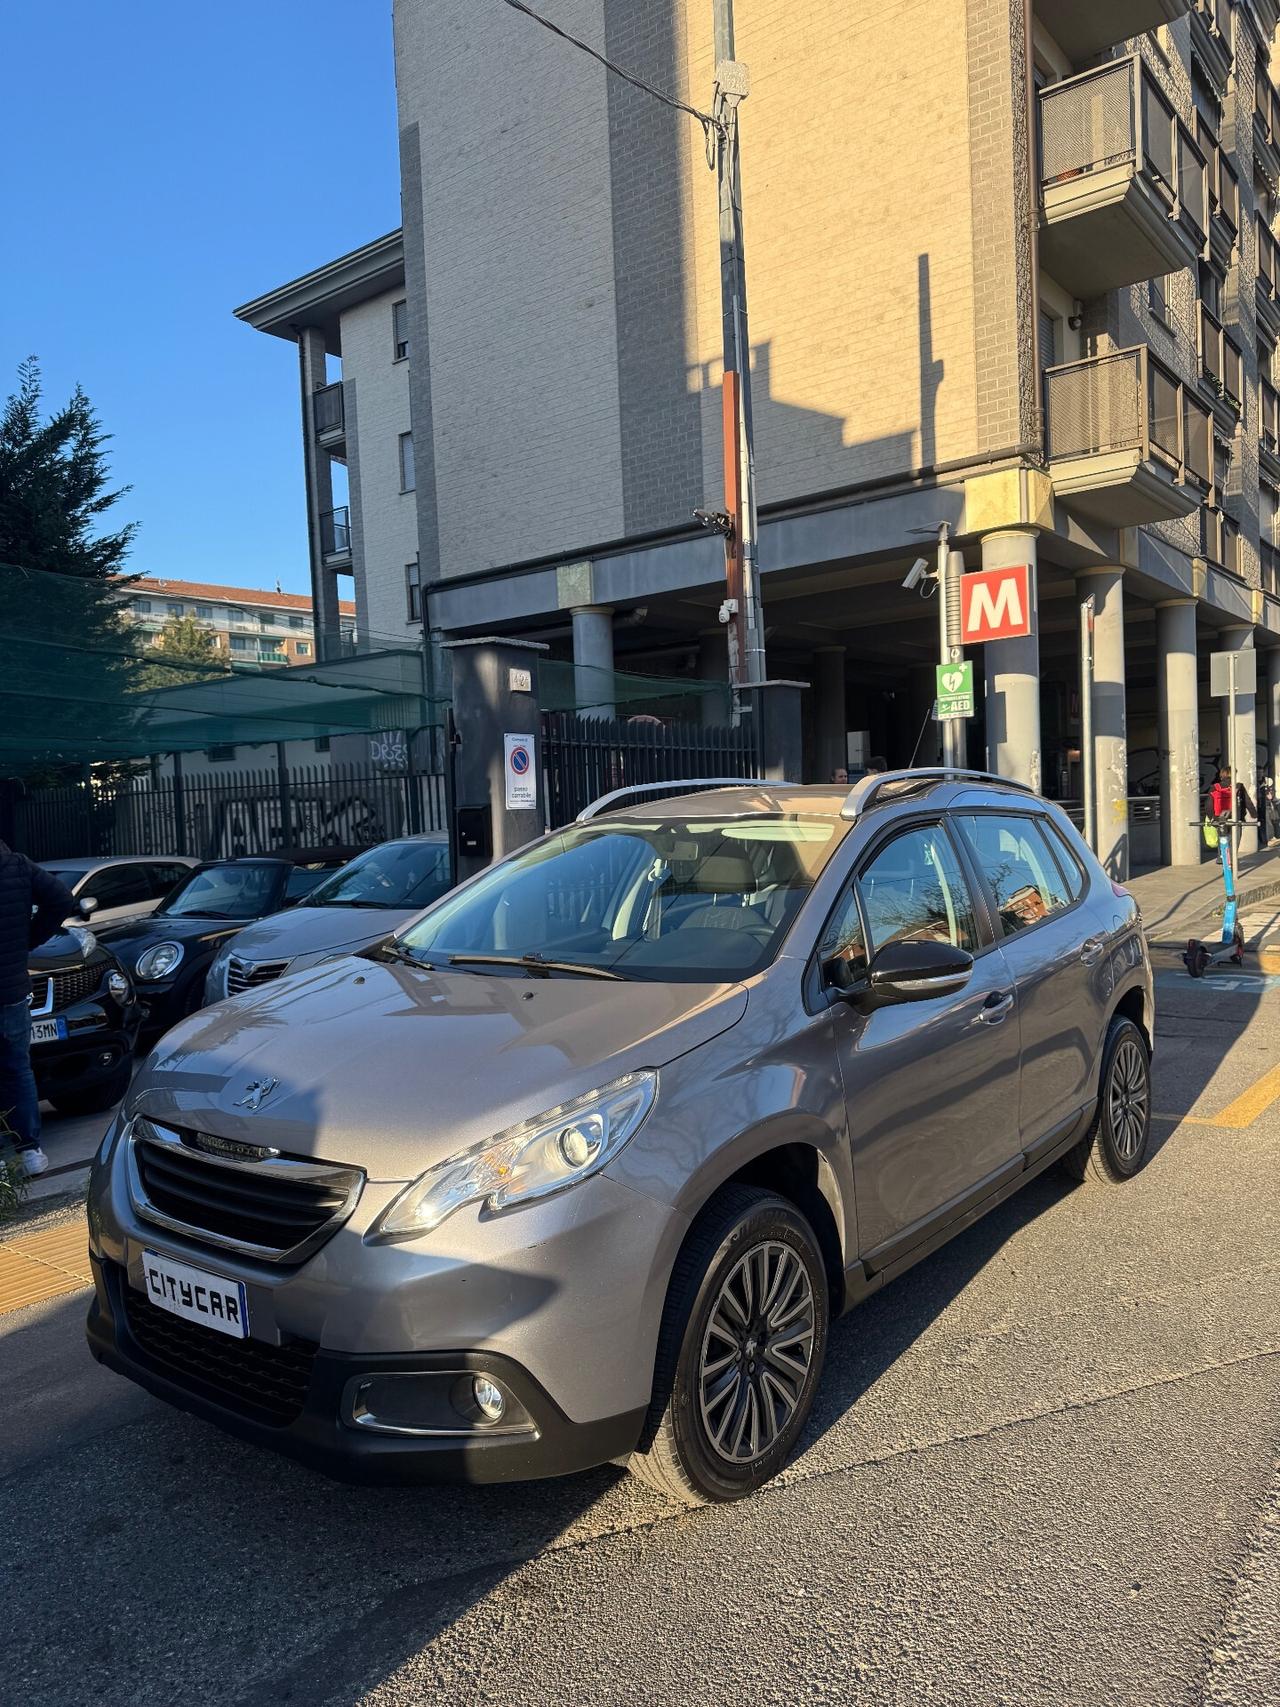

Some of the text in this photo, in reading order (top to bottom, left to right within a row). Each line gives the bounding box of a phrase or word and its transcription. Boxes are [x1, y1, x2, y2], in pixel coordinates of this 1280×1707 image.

[967, 577, 1024, 633] M
[951, 700, 970, 711] AED
[148, 1267, 240, 1325] CITYCAR
